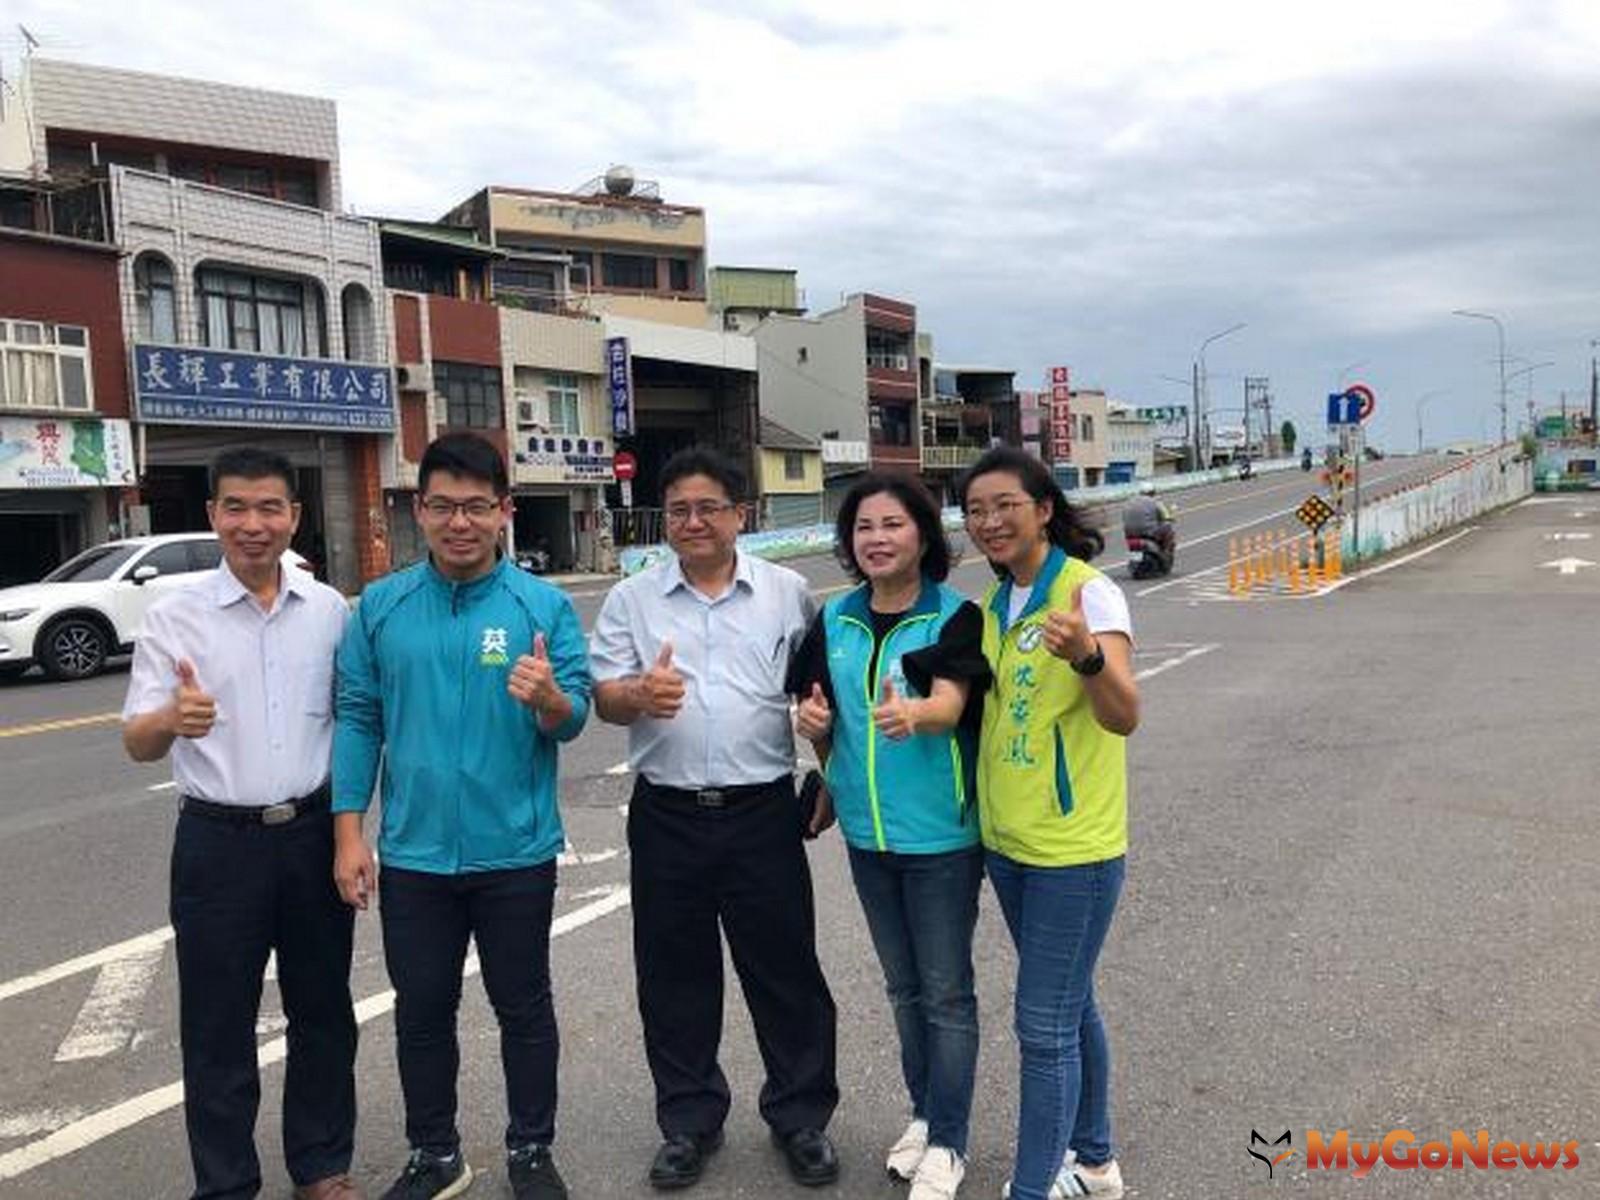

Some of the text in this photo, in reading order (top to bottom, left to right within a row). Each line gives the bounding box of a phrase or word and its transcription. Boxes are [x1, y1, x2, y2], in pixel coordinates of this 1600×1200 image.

[142, 351, 391, 404] 長輝工業有限公司
